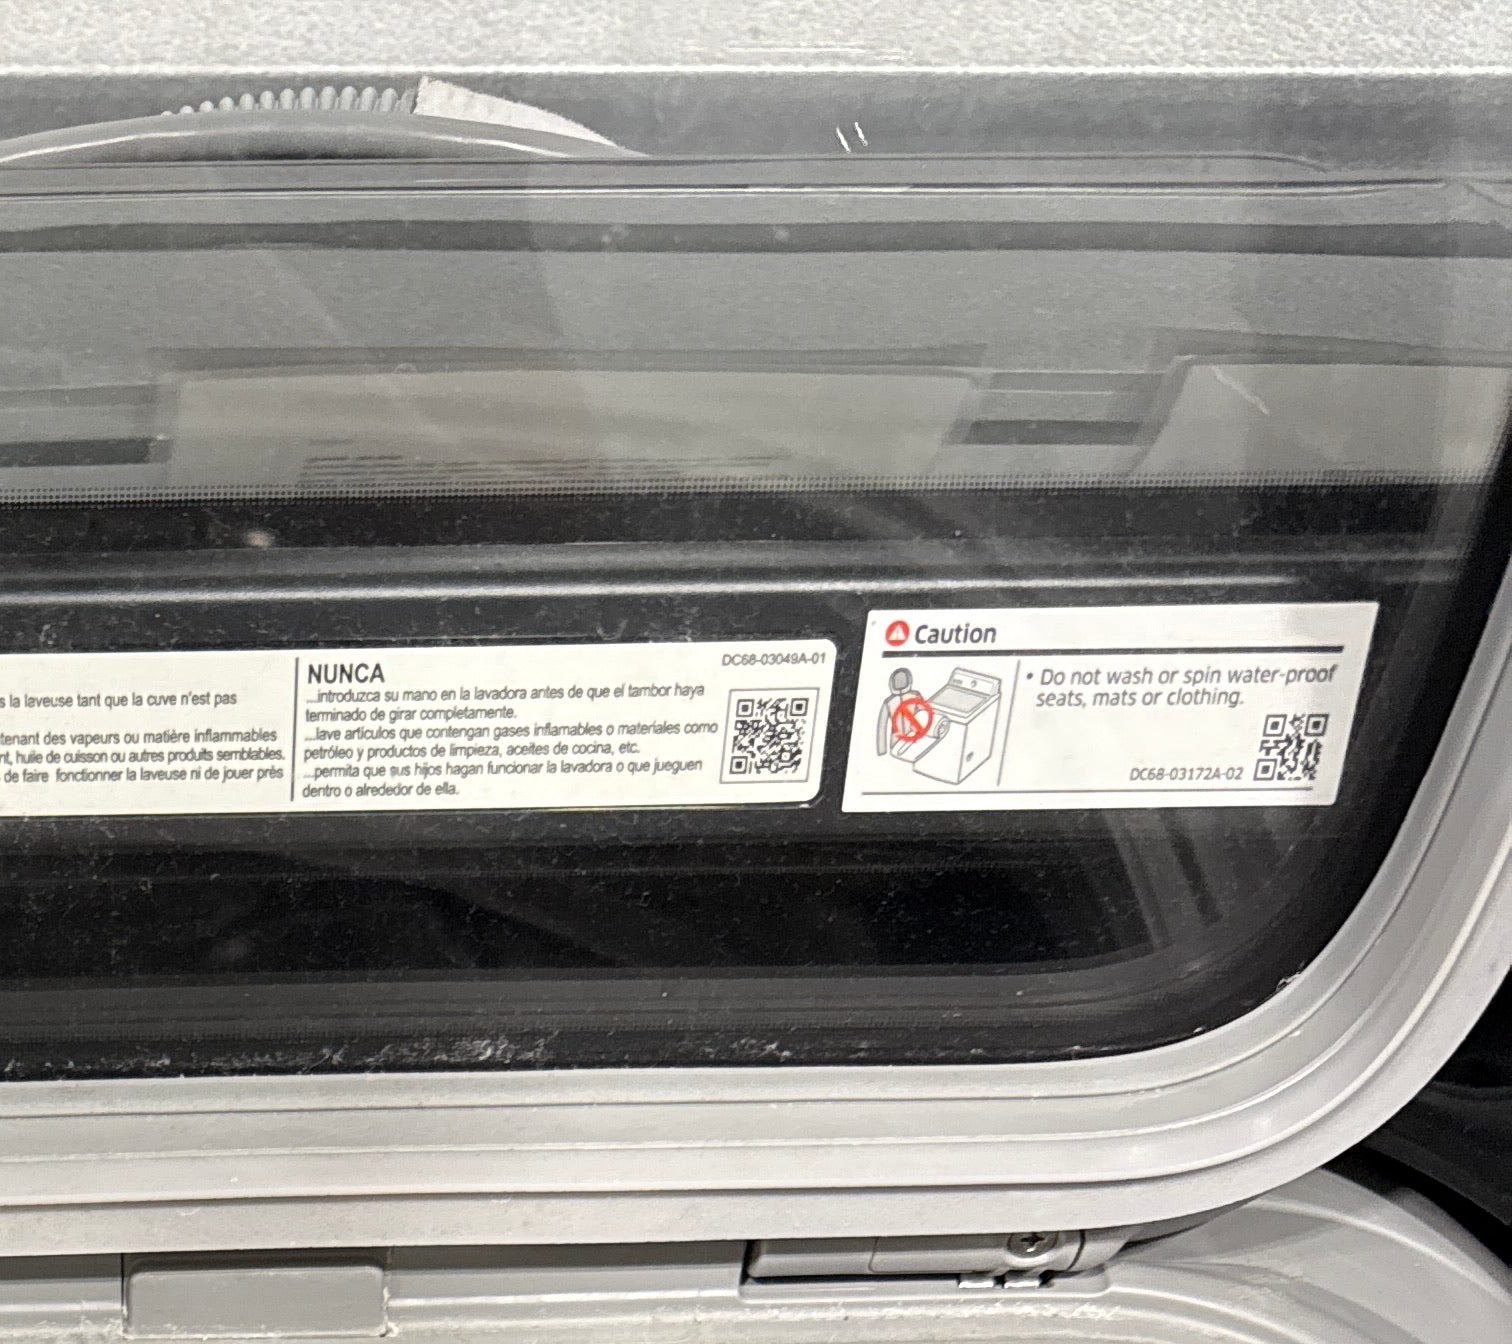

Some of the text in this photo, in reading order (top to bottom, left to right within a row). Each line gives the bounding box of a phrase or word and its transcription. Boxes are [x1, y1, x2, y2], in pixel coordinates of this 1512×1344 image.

[914, 622, 997, 644] Caution
[721, 651, 826, 666] DC68-03049A-01
[307, 662, 385, 684] NUNCA
[1039, 662, 1340, 691] Do not wash or spin water-proof
[8, 693, 20, 708] la
[23, 692, 73, 708] laveuse
[76, 692, 101, 707] tant
[103, 694, 128, 710] que
[131, 691, 143, 707] la
[146, 693, 177, 706] cuve
[180, 690, 211, 706] n'est
[213, 692, 237, 708] pas
[383, 690, 399, 702] su
[402, 689, 438, 701] mano
[440, 689, 456, 701] en
[459, 686, 471, 701] la
[473, 685, 527, 700] lavadora
[529, 685, 564, 700] antes
[566, 684, 584, 699] de
[586, 686, 611, 702] que
[612, 683, 625, 698] el
[627, 683, 672, 698] tambor
[673, 681, 705, 700] haya
[1035, 686, 1244, 709] seats, mats or clothing.
[304, 704, 517, 725] terminado de girar completamente.
[42, 730, 66, 745] des
[69, 732, 120, 748] vapeurs
[123, 732, 139, 744] ou
[142, 728, 190, 744] matière
[193, 727, 277, 743] inflammables
[343, 725, 396, 741] artículos
[398, 727, 423, 742] que
[425, 724, 490, 741] contengan
[492, 725, 530, 741] gases
[533, 721, 603, 737] inflamables
[605, 724, 615, 736] o
[617, 720, 681, 735] materiales
[683, 722, 718, 734] como
[15, 749, 43, 764] huile
[45, 749, 61, 764] de
[63, 749, 108, 764] cuisson
[109, 751, 126, 763] ou
[127, 748, 165, 763] autres
[167, 747, 214, 765] produits
[215, 746, 285, 761] semblables.
[303, 740, 640, 763] petróleo y productos de limpieza, aceites de cocina, etc.
[3, 768, 19, 783] de
[21, 767, 49, 783] faire
[55, 767, 123, 782] fonctionner
[125, 766, 137, 781] la
[139, 766, 187, 781] laveuse
[189, 765, 201, 780] ni
[203, 765, 220, 780] de
[221, 765, 254, 784] jouer
[256, 764, 284, 782] près
[362, 765, 386, 780] que
[389, 764, 411, 777] sus
[413, 761, 442, 780] hijos
[445, 761, 484, 779] hagan
[486, 760, 544, 775] funcionar
[545, 759, 557, 774] la
[560, 758, 613, 773] lavadora
[615, 761, 624, 773] o
[626, 760, 651, 775] que
[651, 757, 703, 775] jueguen
[1128, 766, 1244, 781] DC68-03172A-02
[301, 780, 459, 798] dentro o alrededor de ella.
